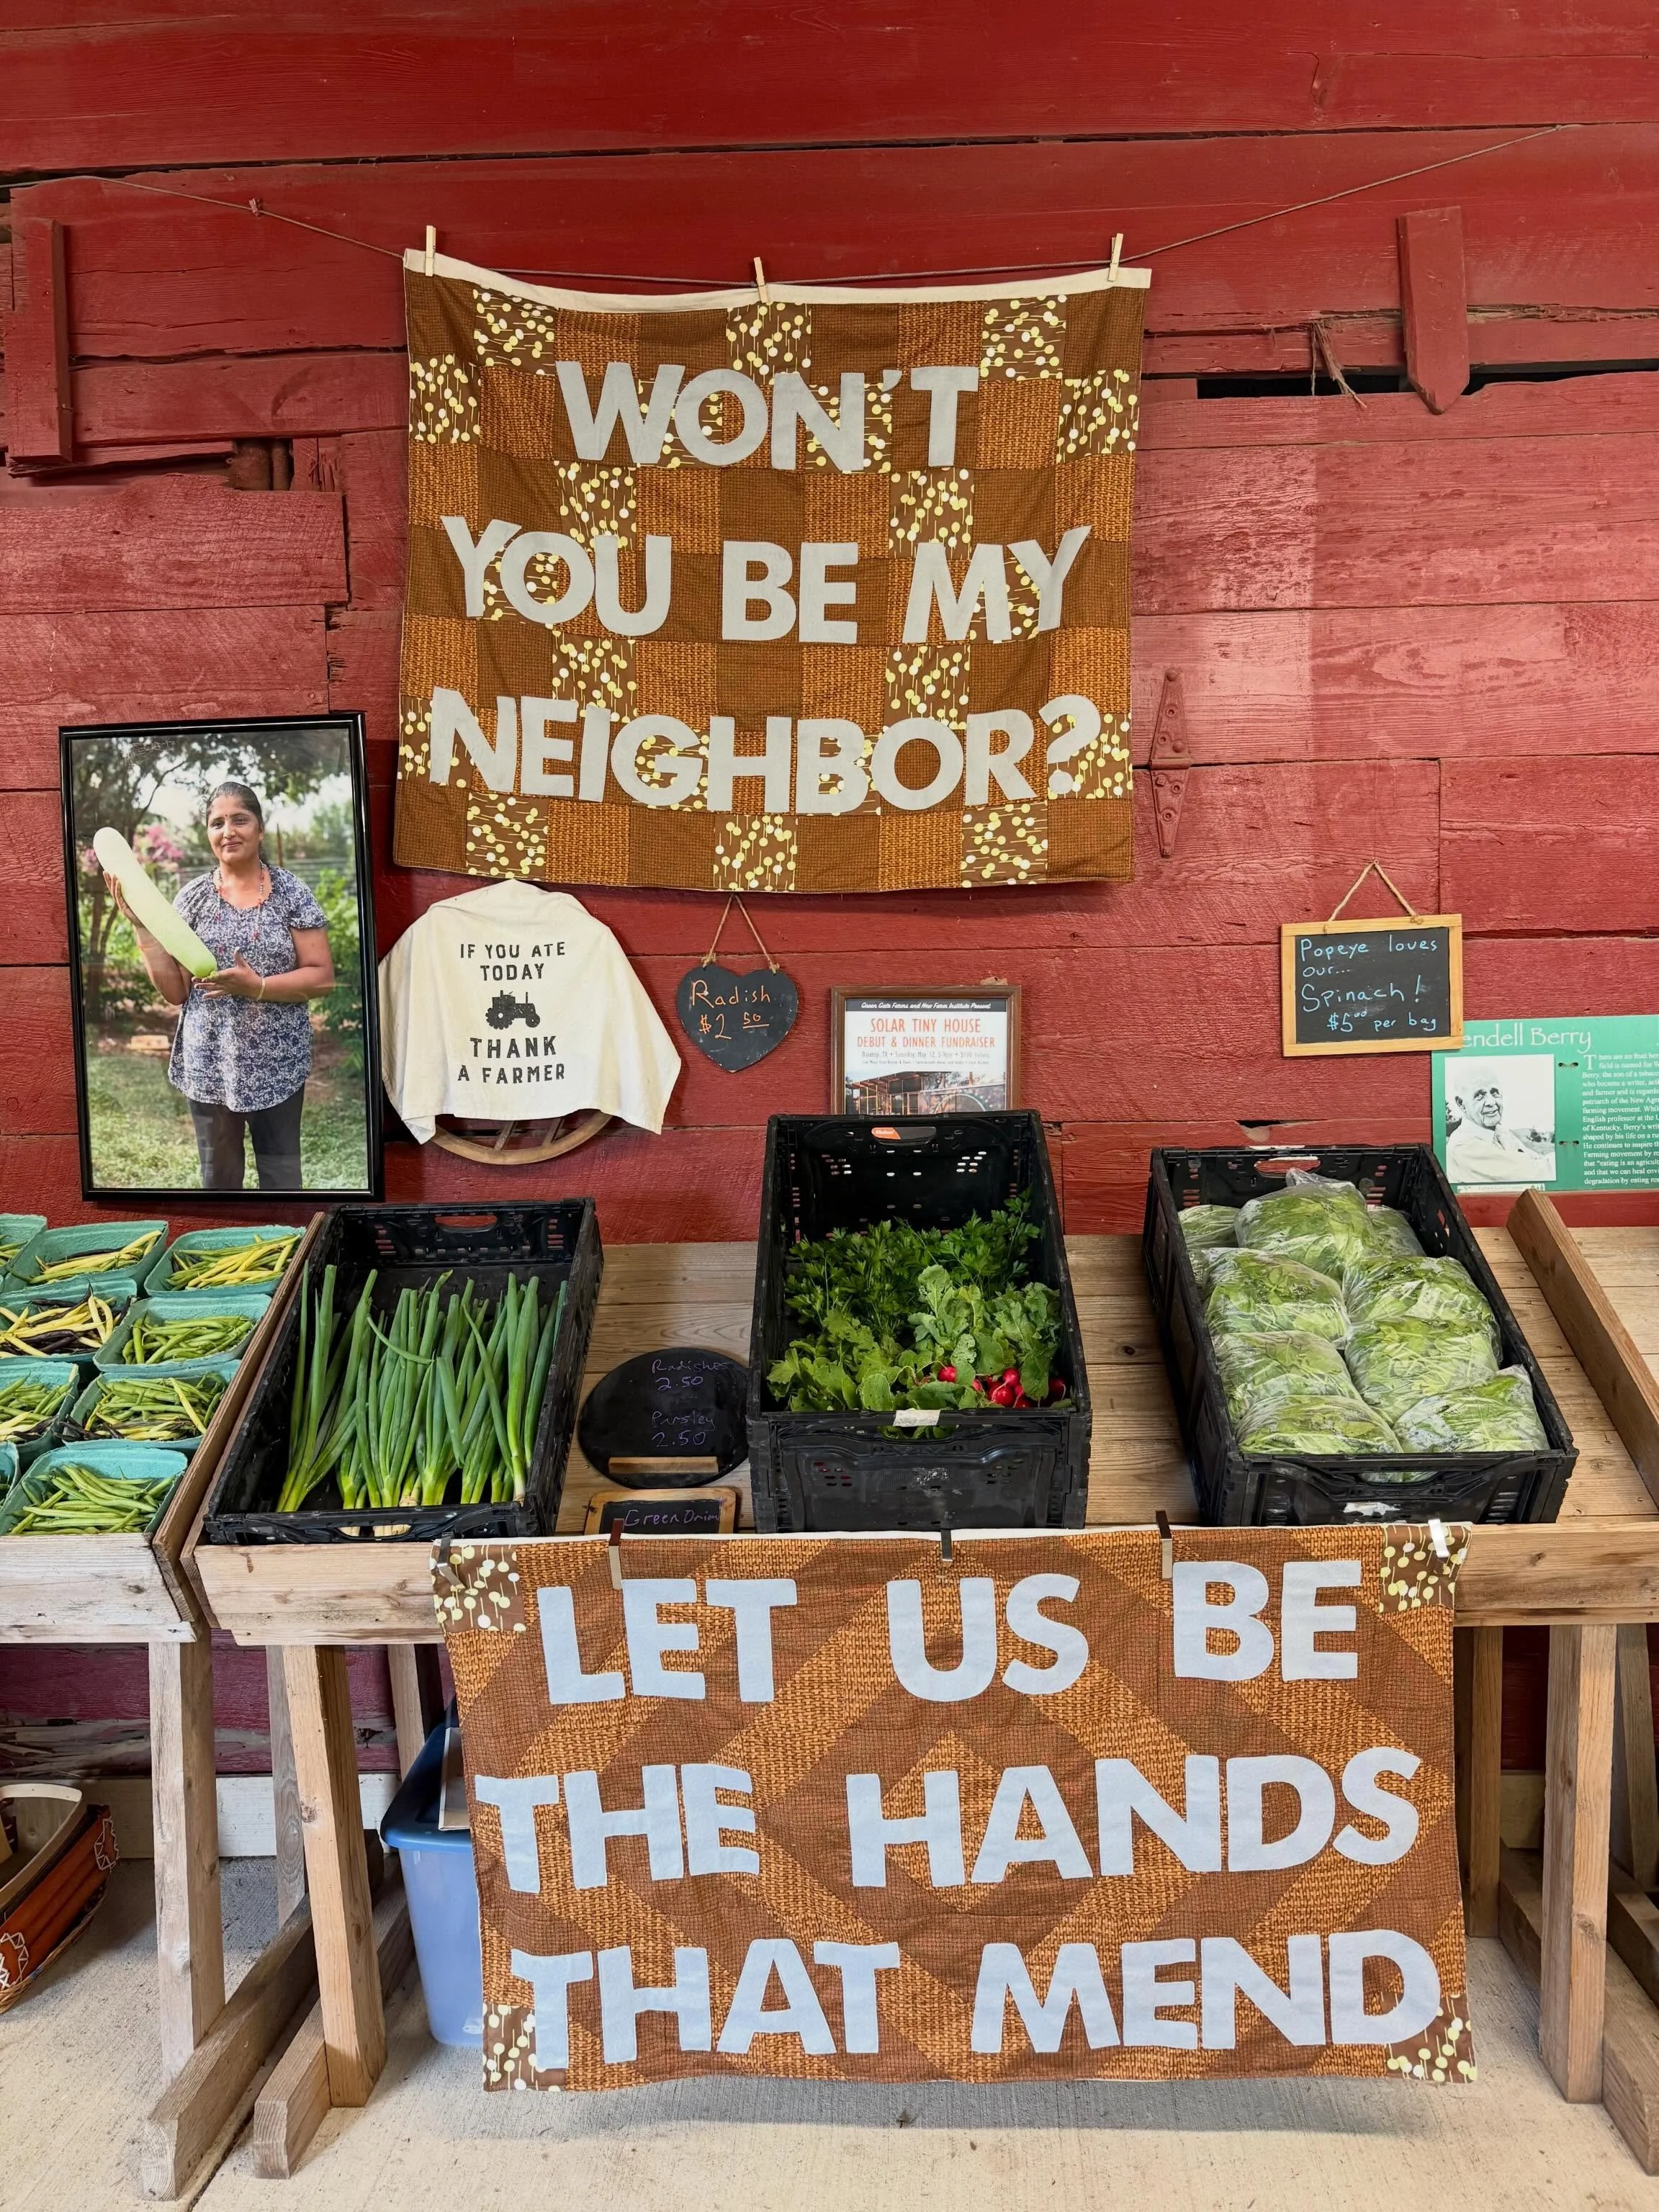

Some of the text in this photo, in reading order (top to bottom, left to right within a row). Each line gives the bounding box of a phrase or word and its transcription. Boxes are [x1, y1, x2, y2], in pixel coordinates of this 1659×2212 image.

[556, 361, 979, 472] WON'T
[441, 516, 1092, 644] YOU BE MY
[430, 686, 1101, 816] NEIGHBOR?
[459, 941, 566, 959] IF YOU ATE
[1300, 934, 1438, 962] Popeye loves
[480, 963, 544, 981] TODAY
[1302, 966, 1351, 978] our...
[691, 979, 771, 1009] Radish
[871, 1018, 981, 1033] SOLAR TINY HOUSE
[1373, 1019, 1397, 1032] per
[1408, 1012, 1437, 1032] bag
[469, 1035, 557, 1059] THANK
[857, 1036, 995, 1048] DEBUT & DINNER FUNDRAISER
[1462, 1022, 1592, 1054] endell Berry
[457, 1063, 565, 1084] A FARMER
[655, 1375, 703, 1391] 2.50
[652, 1431, 706, 1447] 2.50
[624, 1509, 680, 1527] Green
[536, 1560, 1362, 1706] LET US BE
[474, 1745, 1423, 1894] THE HANDS
[510, 1928, 1441, 2071] THAT MEND
